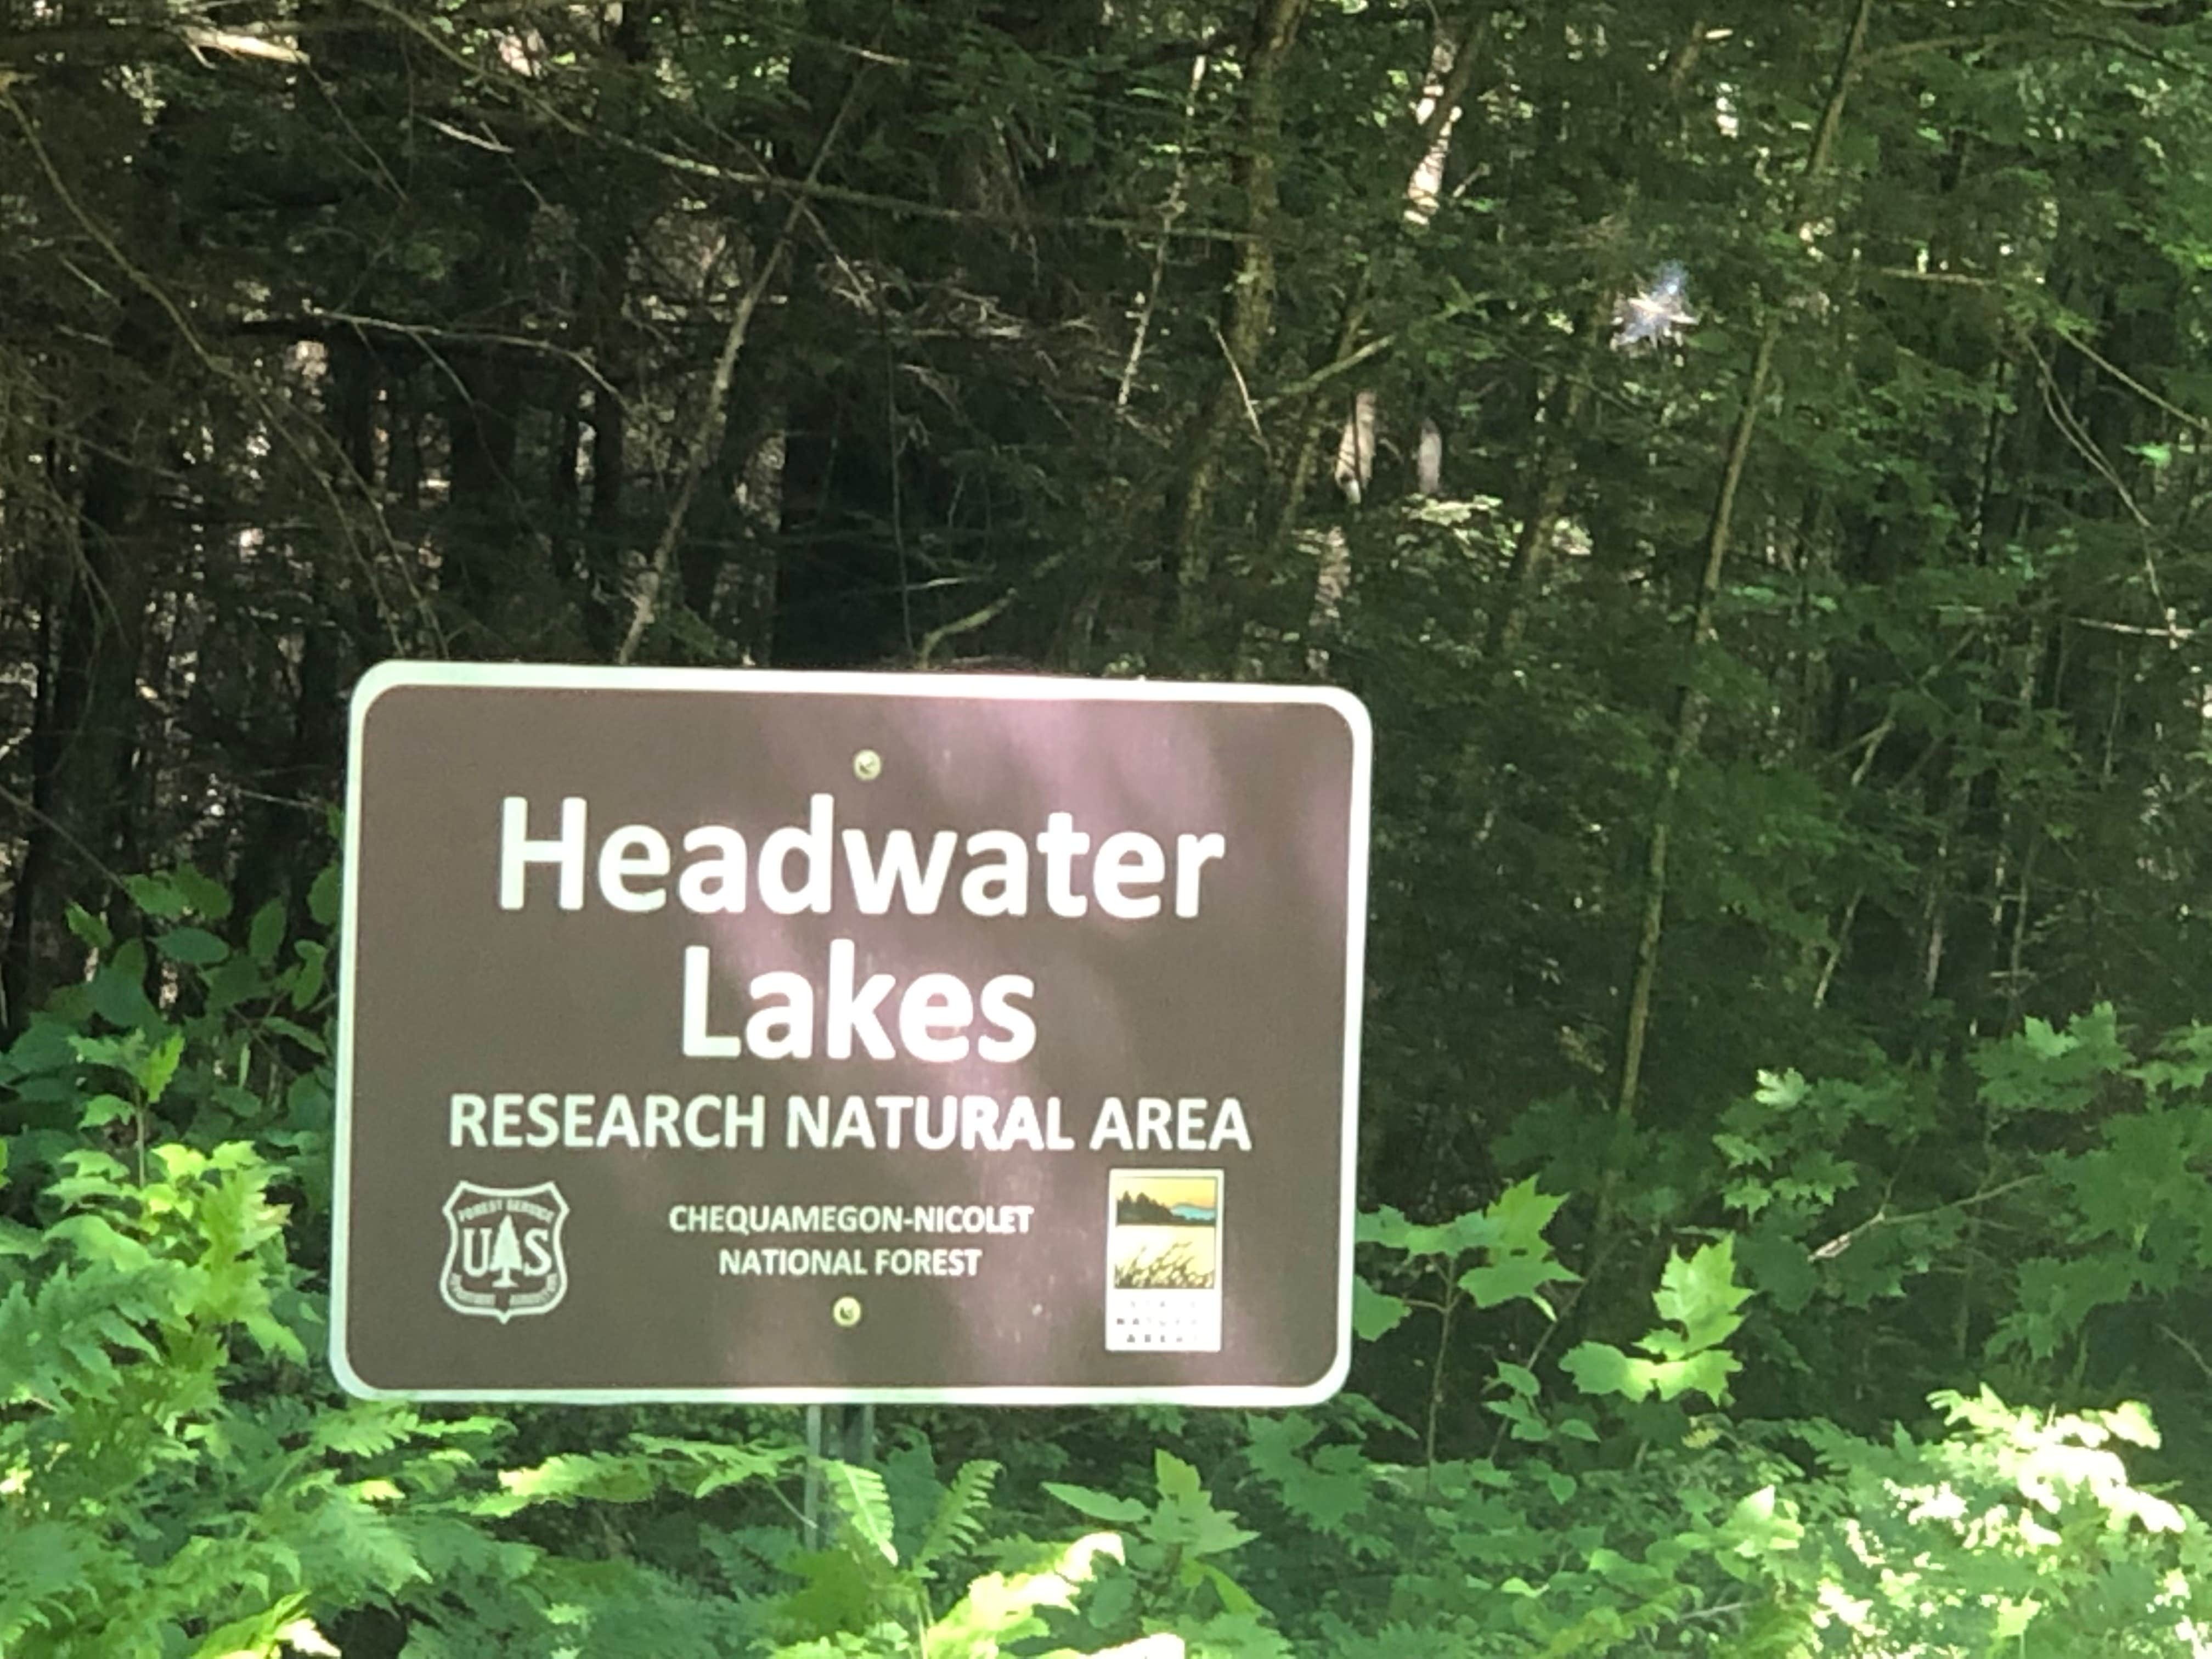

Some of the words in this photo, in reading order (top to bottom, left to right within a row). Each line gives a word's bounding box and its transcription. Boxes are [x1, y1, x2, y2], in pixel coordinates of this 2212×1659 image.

[501, 793, 1224, 918] Headwater
[684, 939, 1036, 1065] Lakes
[450, 1094, 764, 1148] RESEARCH
[788, 1095, 1073, 1151] NATURAL
[1090, 1097, 1251, 1150] AREA
[669, 1205, 1034, 1235] CHEQUAMEGON-NICOLET
[720, 1249, 867, 1276] NATIONAL
[876, 1249, 981, 1277] FOREST
